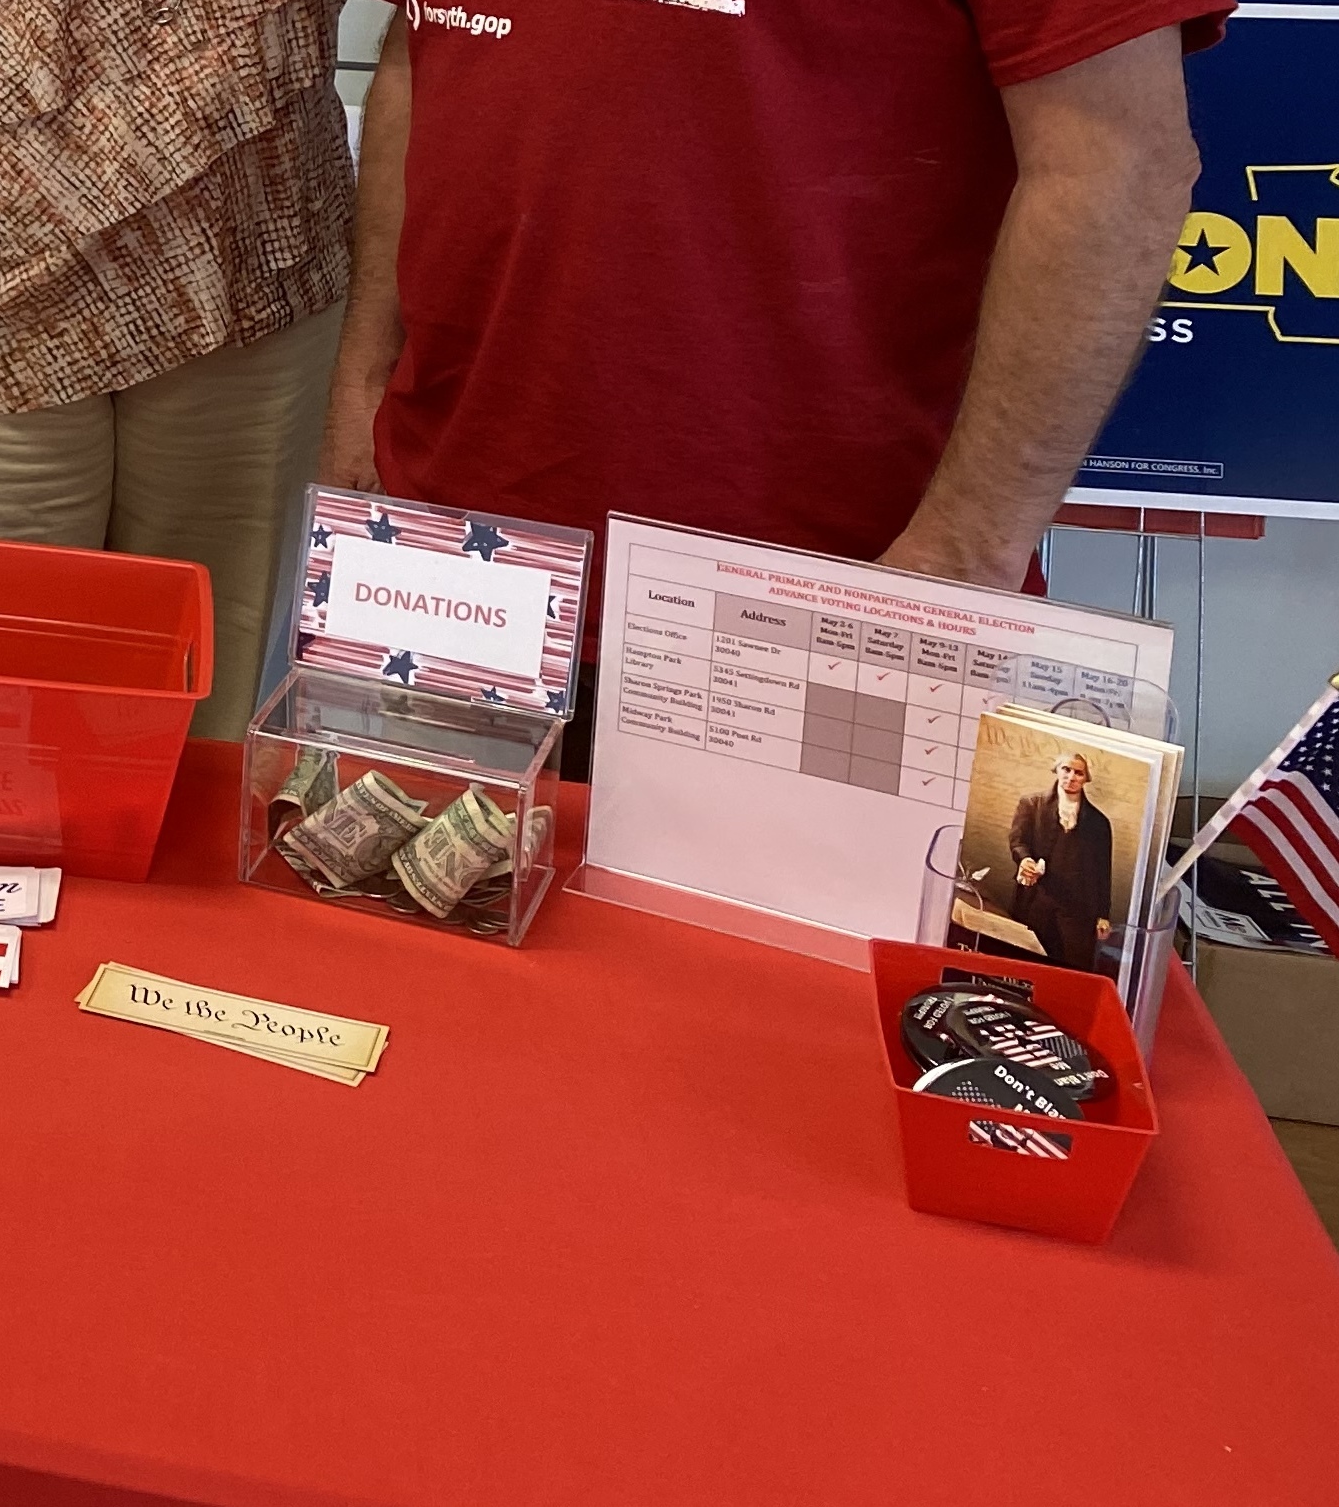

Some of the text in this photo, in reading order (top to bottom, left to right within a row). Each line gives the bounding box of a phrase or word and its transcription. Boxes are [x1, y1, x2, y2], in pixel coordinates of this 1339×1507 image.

[1089, 460, 1149, 470] HANSON FOR
[354, 582, 508, 628] DONATIONS
[648, 590, 695, 608] Location
[740, 609, 787, 627] Address
[769, 573, 815, 590] PRIMARY
[818, 583, 841, 595] AND
[923, 606, 975, 624] GENERAL
[978, 616, 1035, 635] ELECTION
[769, 587, 818, 604] ADVANCE
[820, 596, 861, 612] VOTING
[938, 621, 977, 636] HOURS
[127, 983, 345, 1047] We People
[994, 1065, 1035, 1102] Don't
